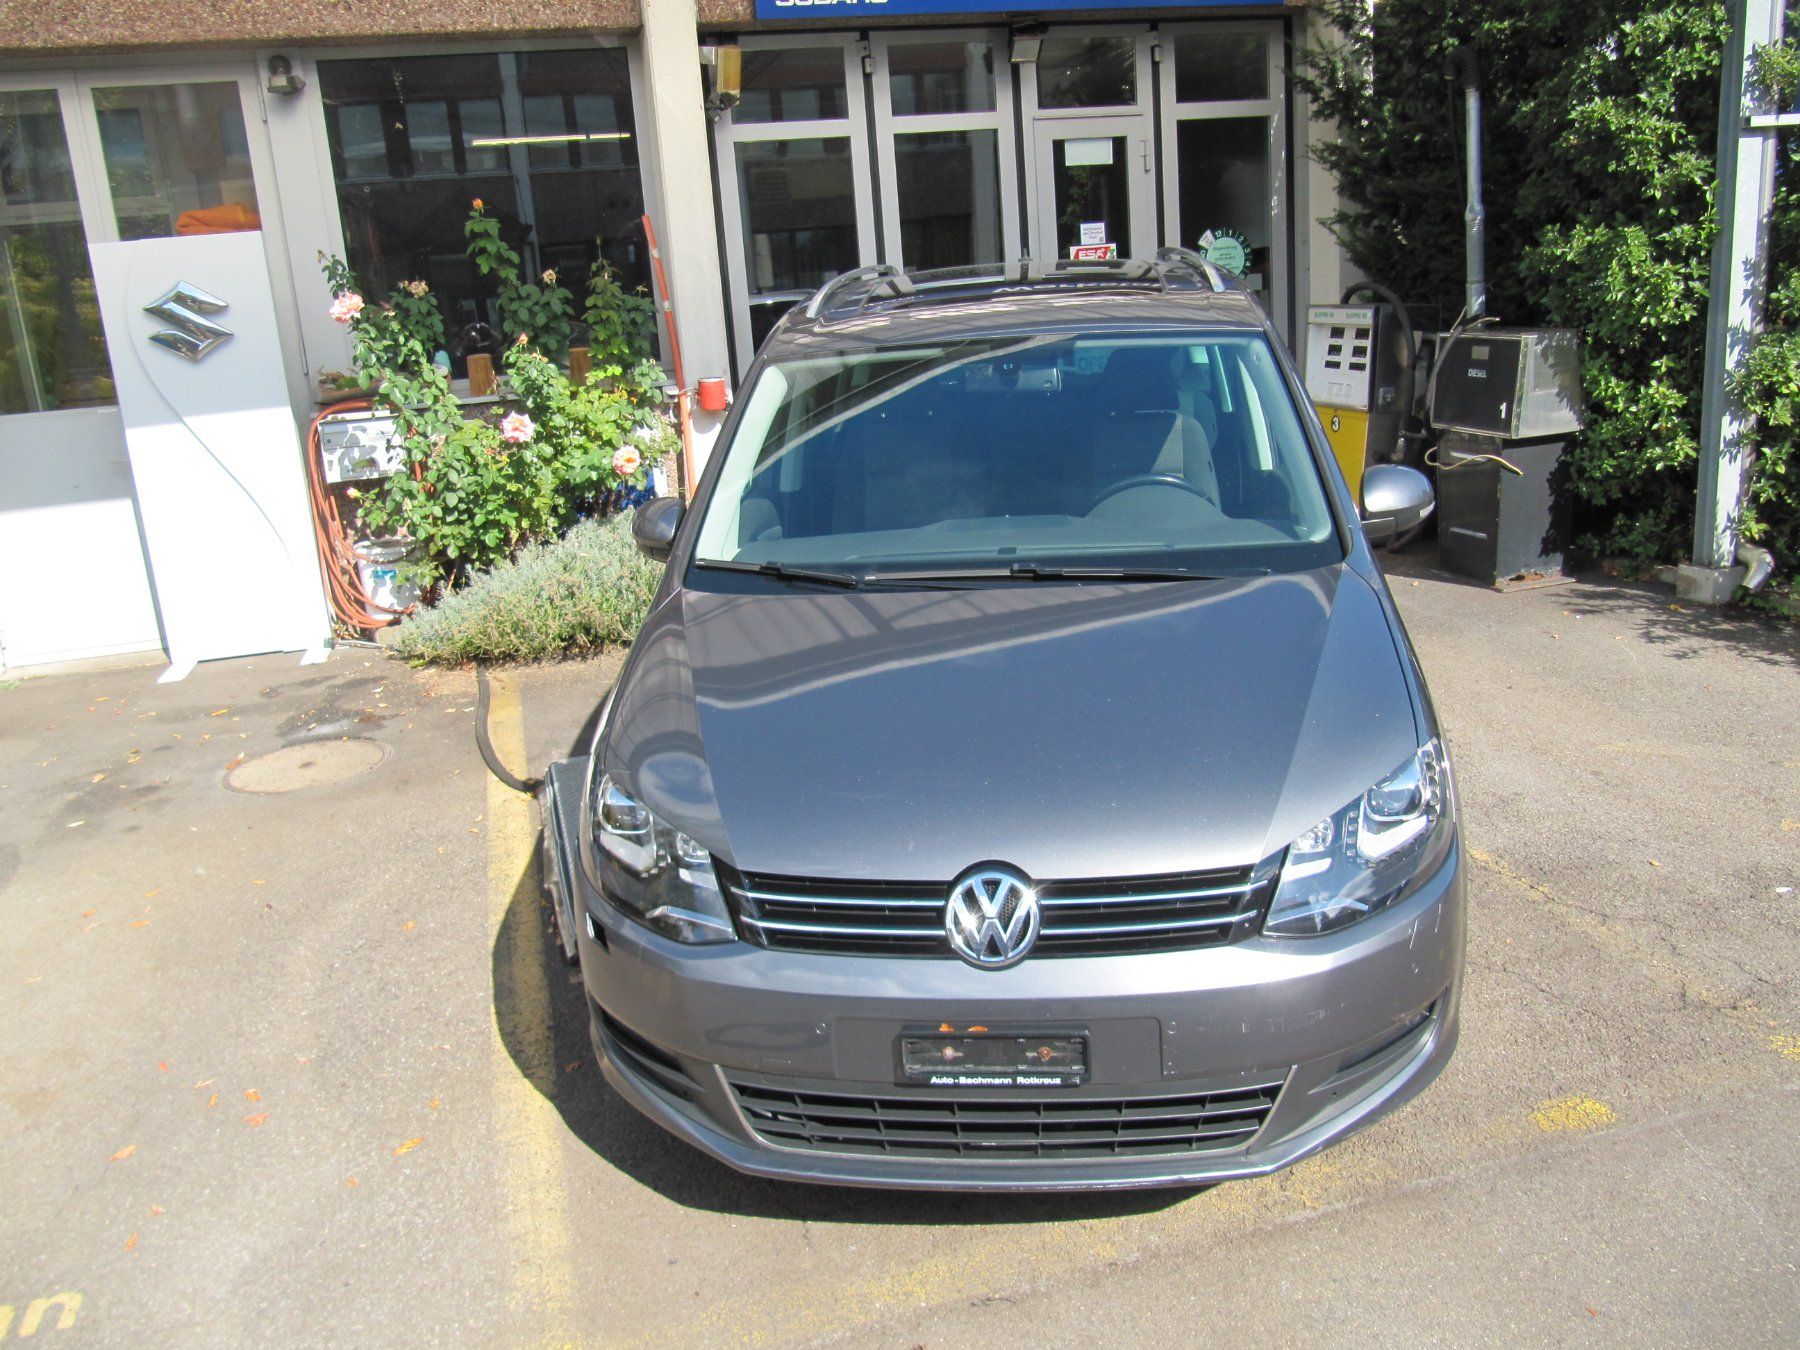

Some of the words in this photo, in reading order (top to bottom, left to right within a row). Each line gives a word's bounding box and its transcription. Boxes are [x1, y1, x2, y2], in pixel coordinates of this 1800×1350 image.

[1467, 368, 1487, 378] DIESEL
[1499, 402, 1507, 419] 1
[1331, 416, 1340, 432] 3
[1016, 1076, 1062, 1085] Rotkreuz
